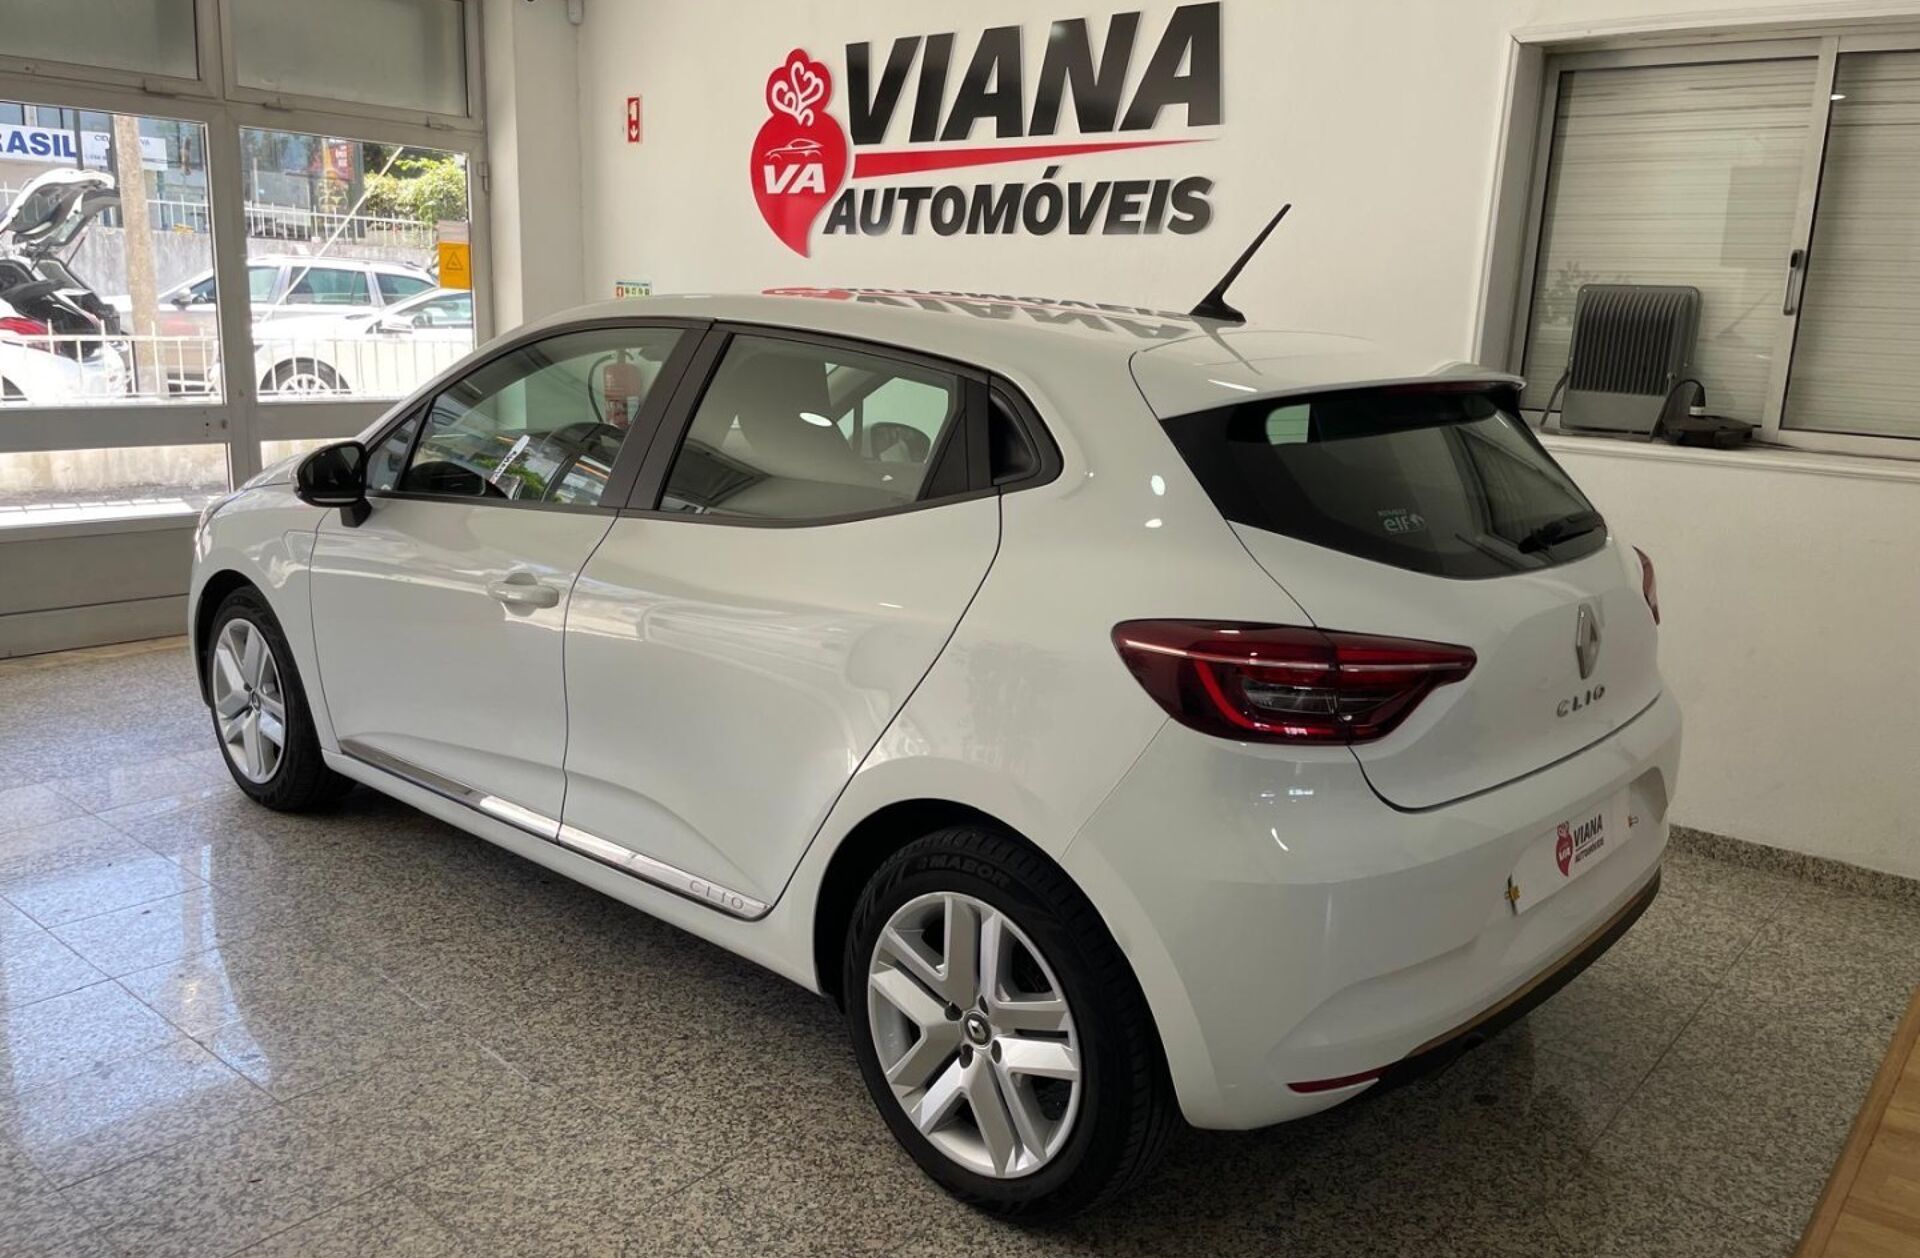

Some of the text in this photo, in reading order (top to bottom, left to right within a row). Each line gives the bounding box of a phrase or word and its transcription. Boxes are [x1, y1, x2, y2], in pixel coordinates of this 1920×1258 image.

[845, 1, 1223, 146] VIANA
[0, 130, 77, 158] ASIL
[763, 163, 827, 194] VA
[823, 165, 1215, 236] AUTOMÓVEIS
[1556, 684, 1605, 718] CLIO
[1573, 814, 1603, 847] VIANA
[689, 879, 745, 911] CLIO
